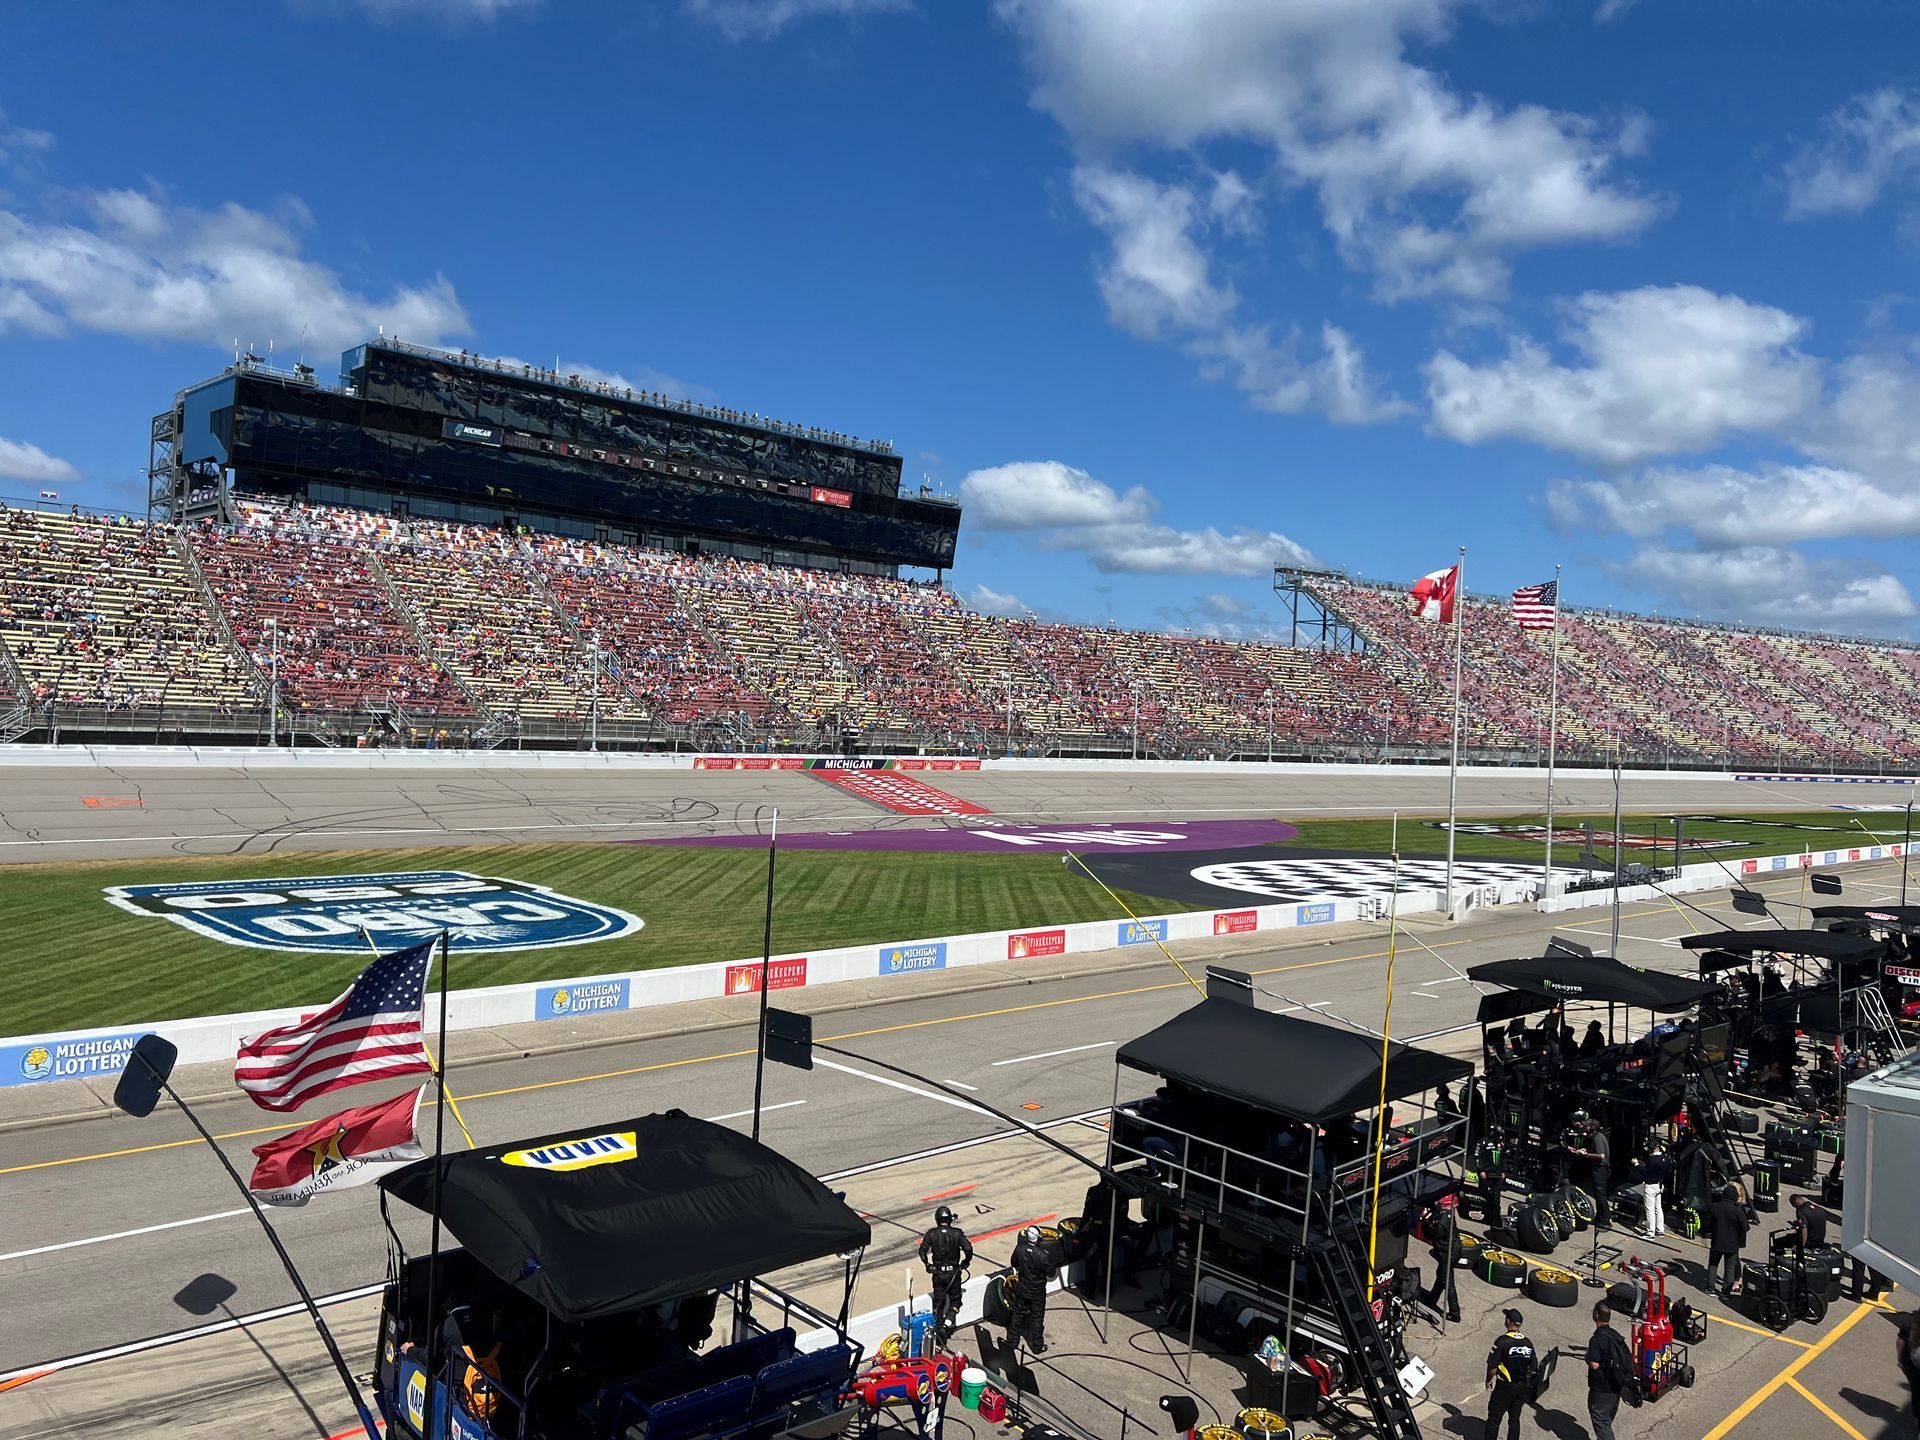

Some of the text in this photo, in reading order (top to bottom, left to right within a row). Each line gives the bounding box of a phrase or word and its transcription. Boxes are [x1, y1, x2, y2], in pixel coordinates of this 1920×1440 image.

[464, 426, 492, 438] MICHIGAN
[824, 760, 874, 769] MICHIGAN
[966, 830, 1189, 846] ally
[163, 880, 502, 909] 250
[303, 898, 449, 912] TEQUILA
[251, 900, 568, 938] CABO
[1310, 913, 1329, 921] LOTTERY
[1136, 930, 1160, 941] LOTTERY
[904, 947, 937, 959] MICHIGAN
[904, 956, 937, 969] LOTTERY
[573, 983, 621, 999] MICHIGAN
[1552, 983, 1582, 992] MONSTER
[572, 994, 621, 1012] LOTTERY
[56, 1037, 135, 1059] MICHIGAN
[55, 1051, 133, 1076] LOTTERY
[526, 1136, 624, 1165] NAPA
[1505, 1178, 1526, 1189] TOYOTA
[1376, 1268, 1394, 1283] ORD
[389, 1320, 396, 1334] 9
[410, 1384, 424, 1417] NAP
